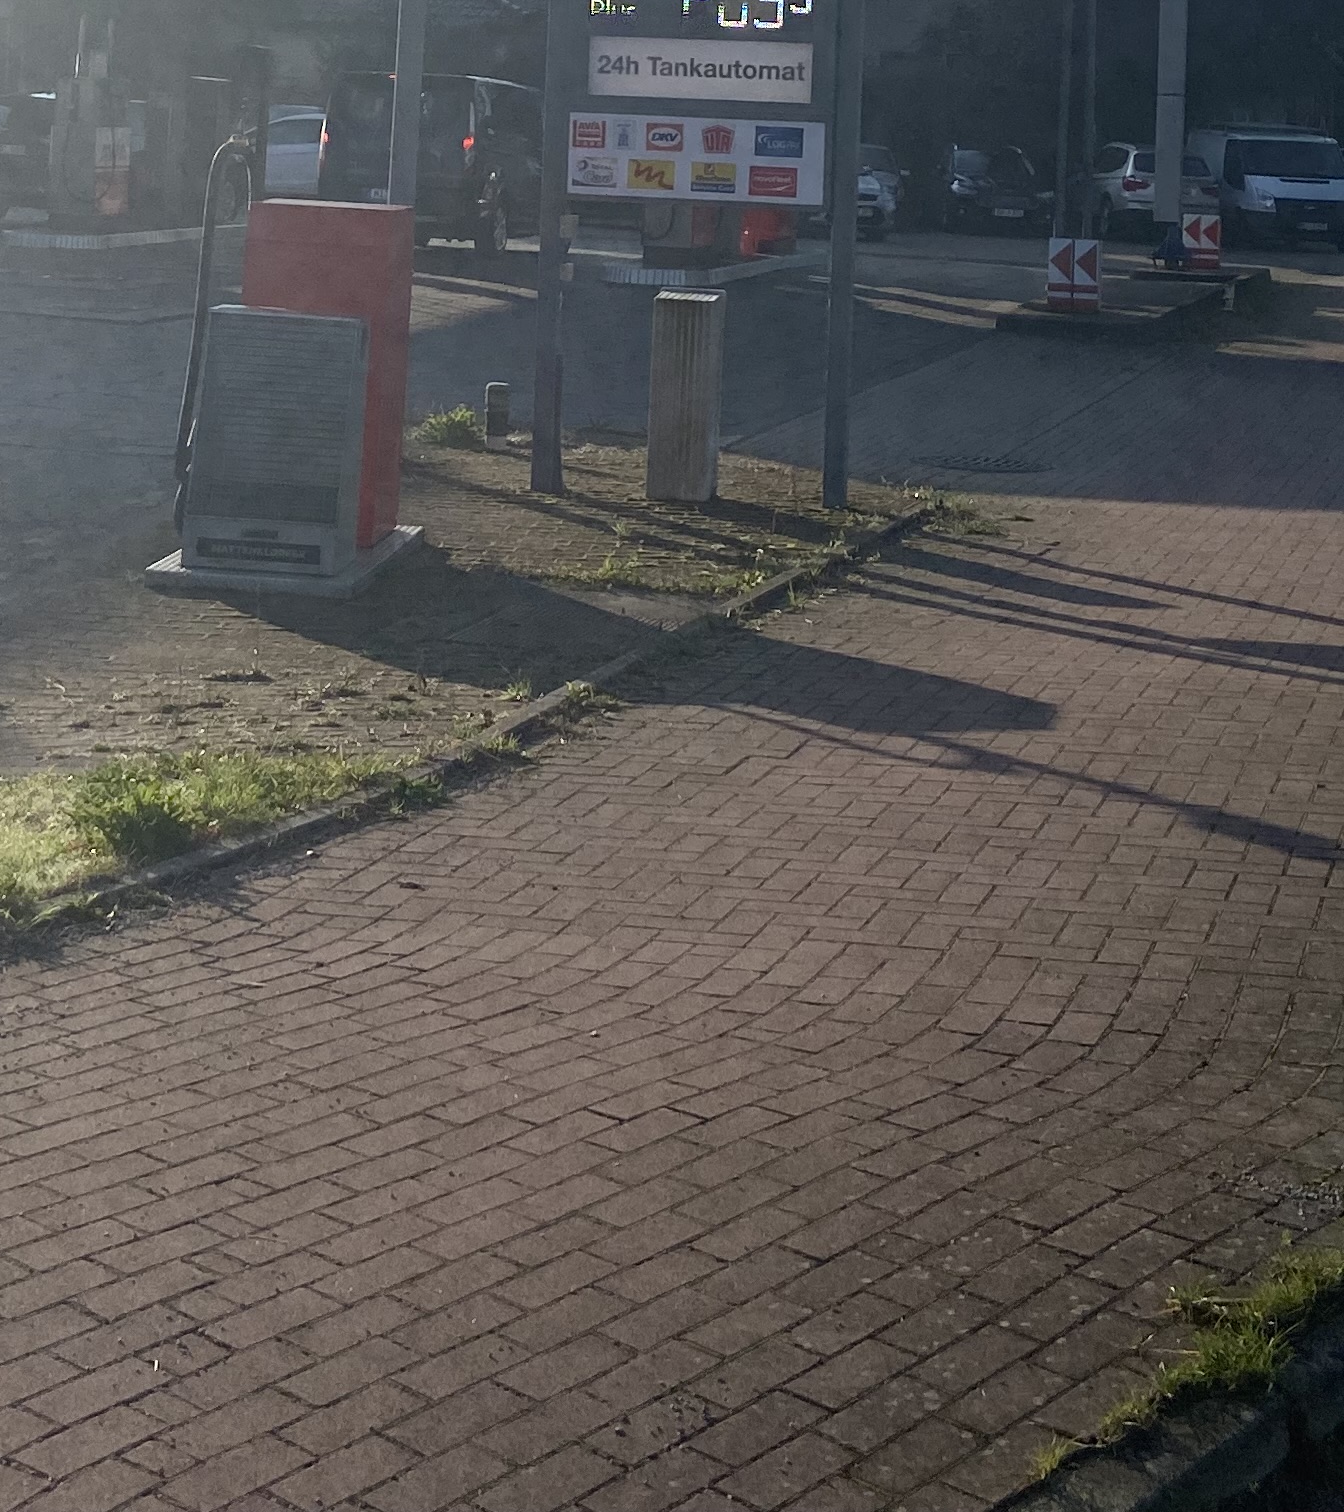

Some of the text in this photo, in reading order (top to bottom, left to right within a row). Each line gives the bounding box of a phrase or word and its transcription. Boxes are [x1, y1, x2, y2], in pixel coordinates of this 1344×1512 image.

[597, 55, 806, 81] 24h Tankautomat
[651, 132, 678, 142] DKV
